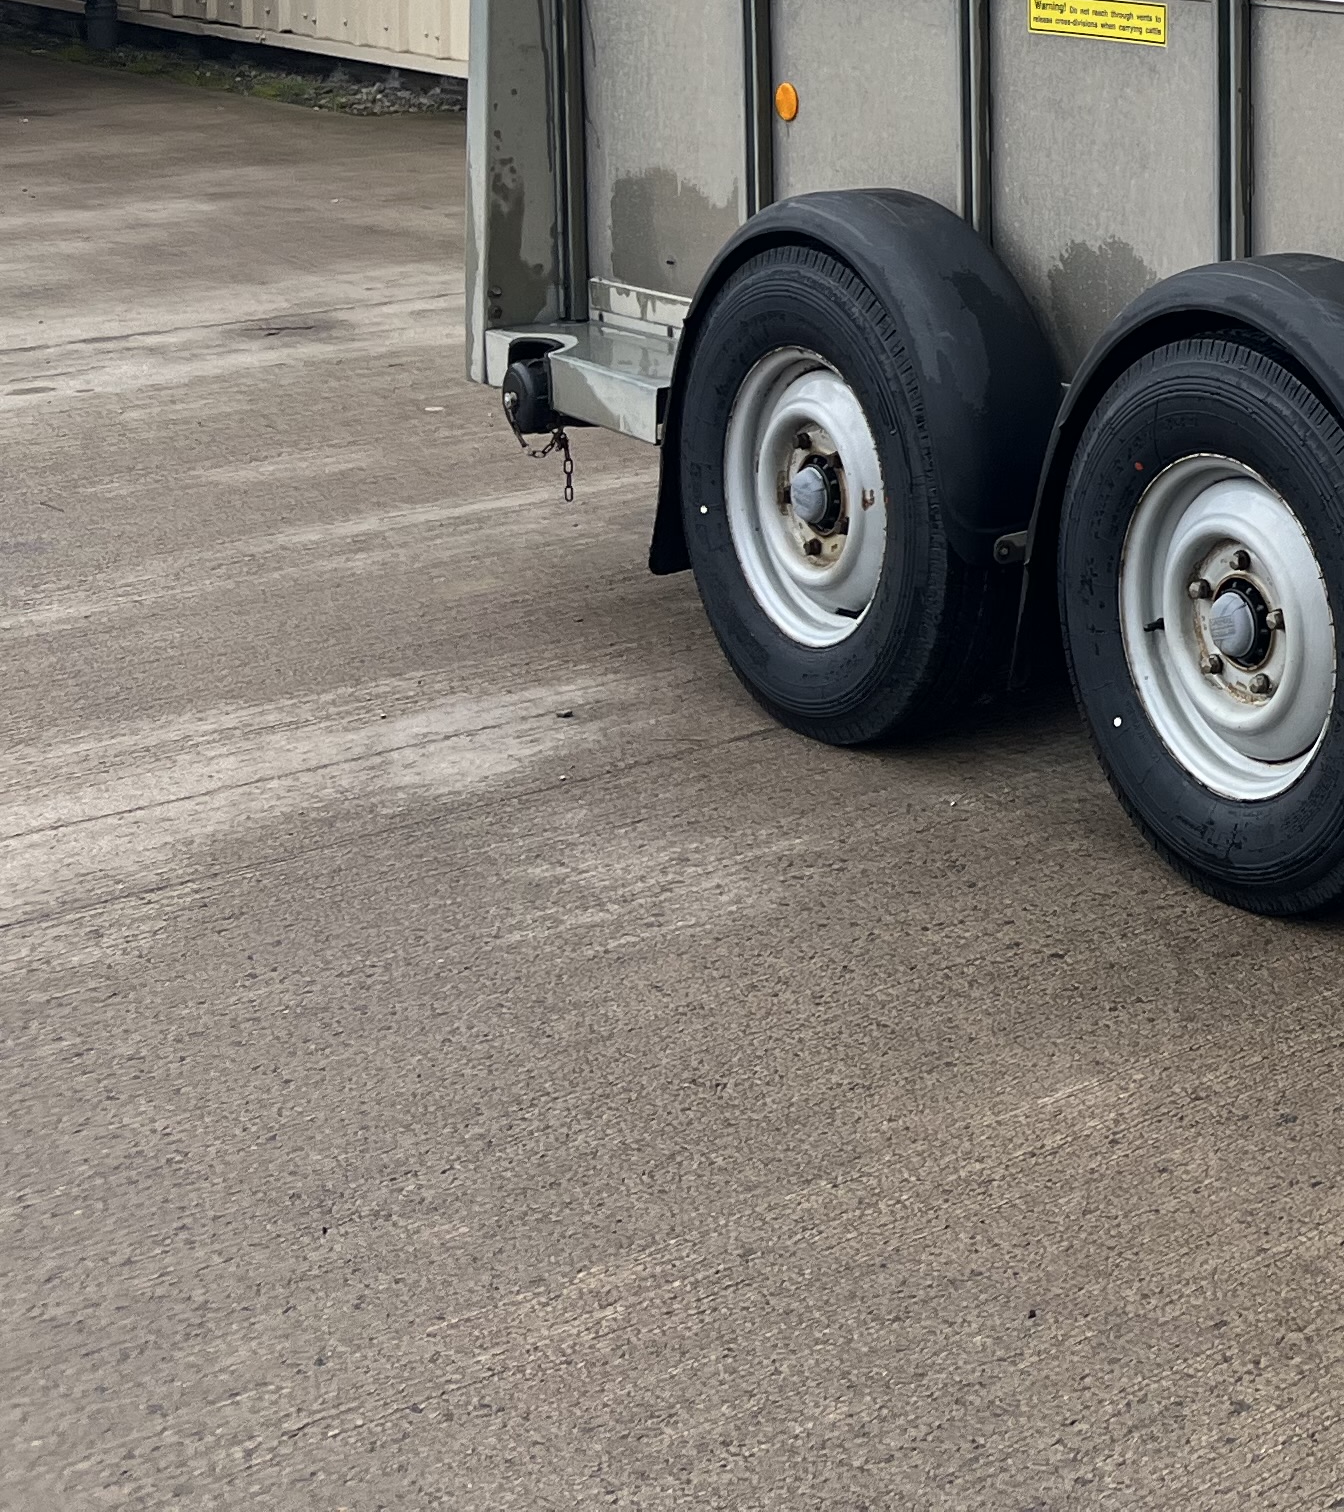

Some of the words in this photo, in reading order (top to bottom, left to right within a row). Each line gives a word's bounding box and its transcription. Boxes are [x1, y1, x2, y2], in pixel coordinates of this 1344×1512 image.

[1034, 0, 1067, 14] Warning!
[1080, 7, 1090, 16] not
[1110, 11, 1134, 21] through
[1033, 15, 1053, 24] release
[1055, 18, 1098, 29] cross-divisions
[1100, 22, 1116, 30] when
[1118, 24, 1143, 35] carrying
